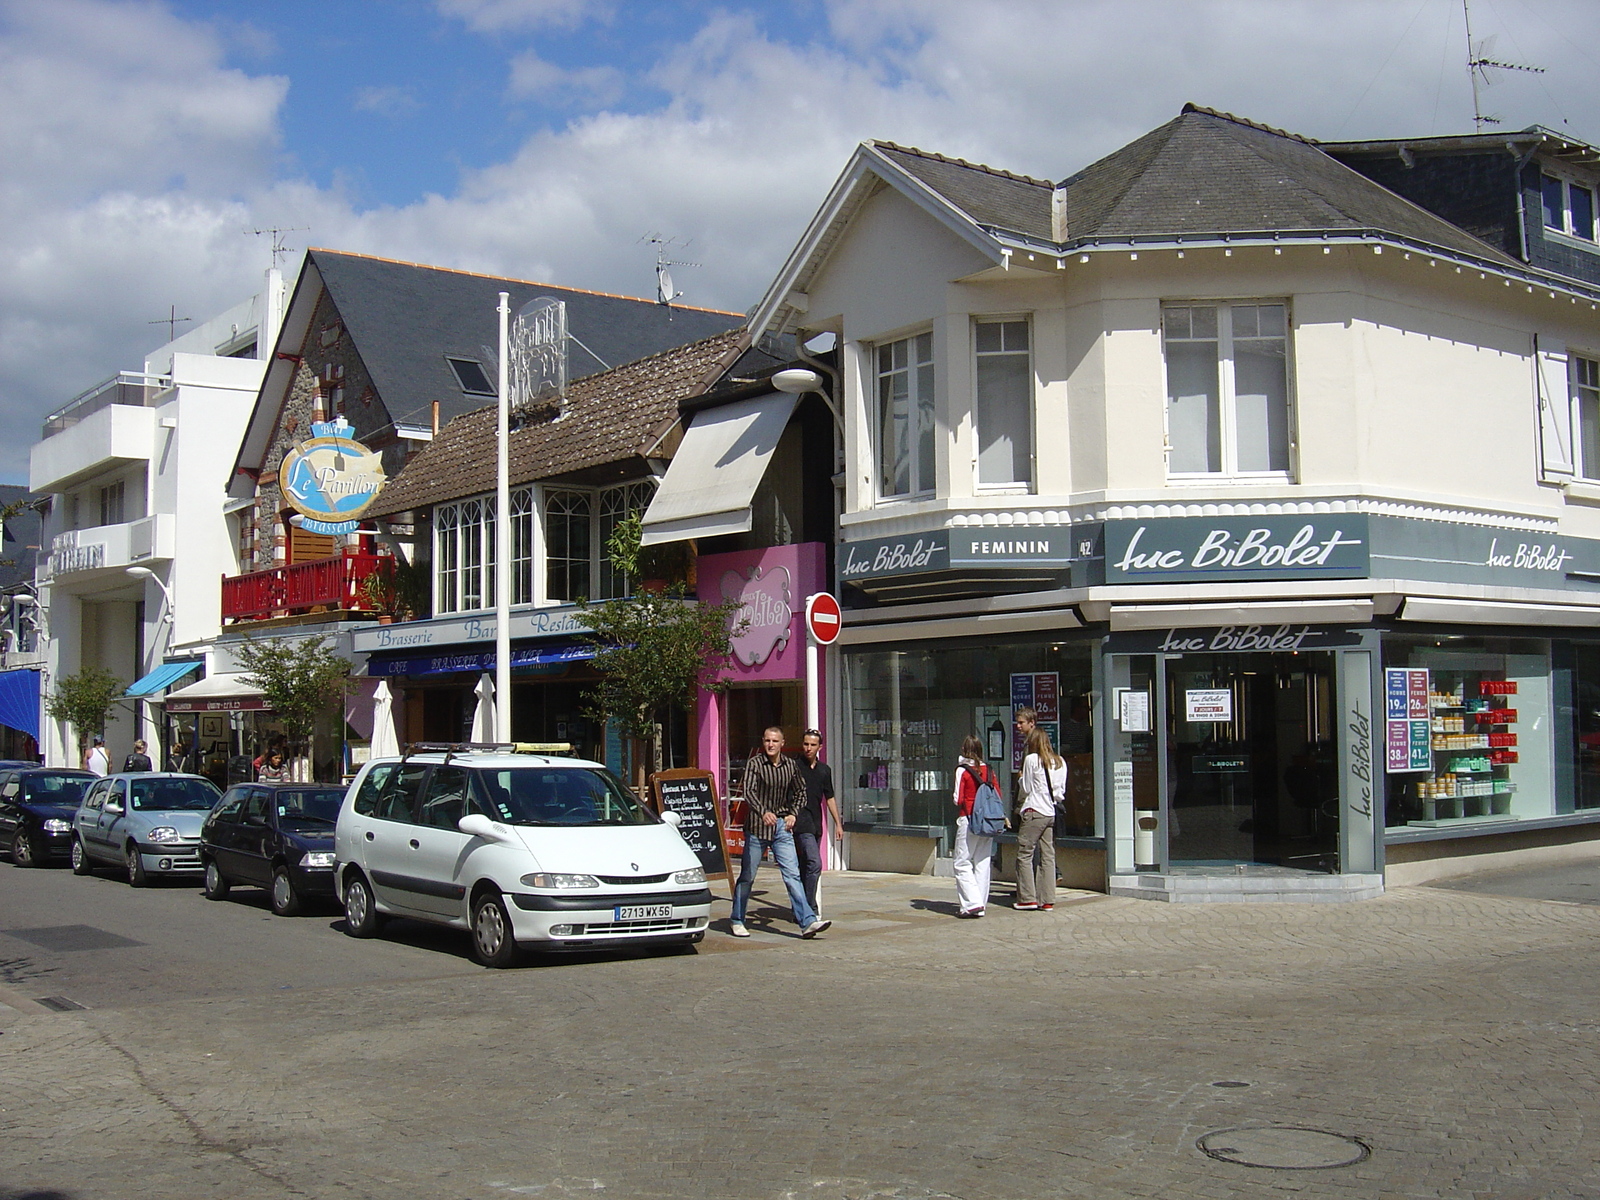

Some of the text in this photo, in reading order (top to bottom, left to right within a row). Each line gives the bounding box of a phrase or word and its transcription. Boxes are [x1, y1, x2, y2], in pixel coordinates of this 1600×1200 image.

[320, 424, 343, 435] Bar
[286, 456, 379, 500] Le Pavillon
[304, 516, 360, 534] Brasserie
[842, 538, 946, 576] Luc BiBolet
[971, 541, 1050, 554] FEMININ
[1080, 541, 1091, 556] 42
[1114, 524, 1362, 571] Luc BiBolet
[1486, 538, 1574, 571] Luc BiBolet
[377, 628, 433, 647] Brasserie
[464, 619, 498, 641] Bar
[1158, 624, 1323, 651] Luc BiBolet
[1348, 698, 1371, 820] Luc BiBolet
[621, 905, 670, 919] 2713 WX 56
